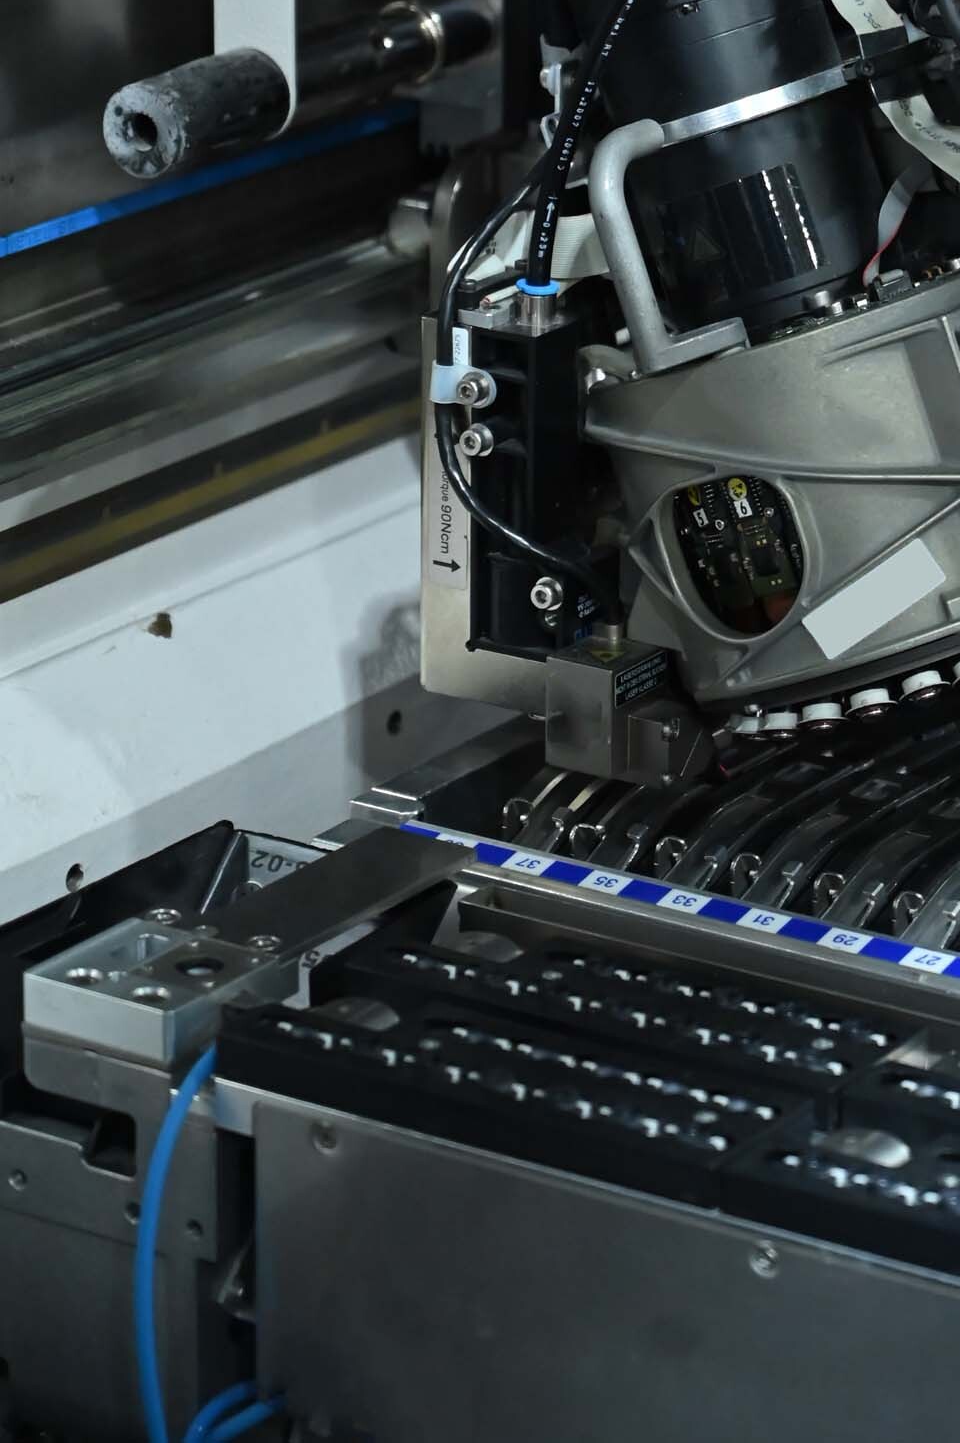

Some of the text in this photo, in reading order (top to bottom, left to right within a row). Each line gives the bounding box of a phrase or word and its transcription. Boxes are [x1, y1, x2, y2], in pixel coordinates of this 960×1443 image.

[440, 504, 452, 554] 90Ncm
[515, 857, 541, 869] 37
[593, 876, 618, 888] 35
[671, 895, 697, 907] 33
[753, 915, 775, 927] 31
[833, 934, 858, 947] 29
[914, 954, 942, 966] 27
